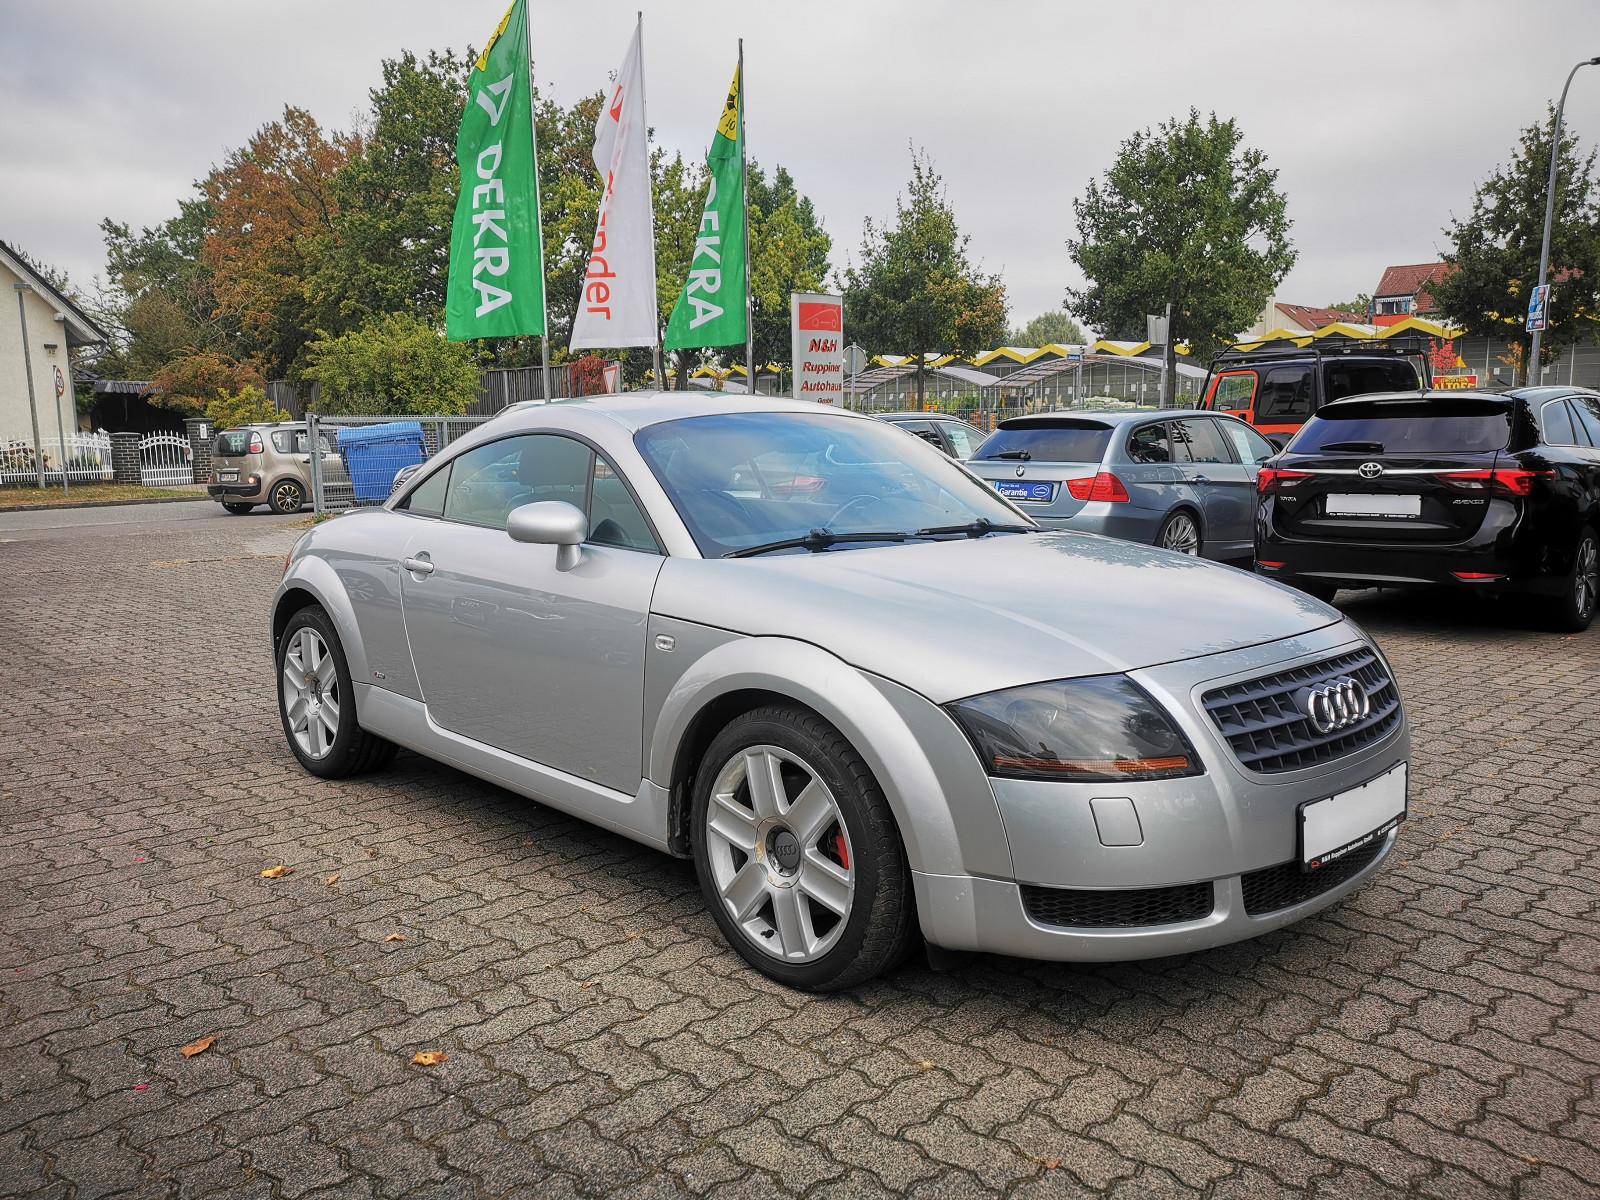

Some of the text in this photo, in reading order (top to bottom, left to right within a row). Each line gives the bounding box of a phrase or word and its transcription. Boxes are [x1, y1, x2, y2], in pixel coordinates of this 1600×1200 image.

[472, 140, 513, 319] DEKRA
[808, 338, 838, 353] N&H
[803, 361, 841, 375] Ruppiner
[800, 380, 842, 392] Autohaus
[999, 487, 1028, 497] Garantie
